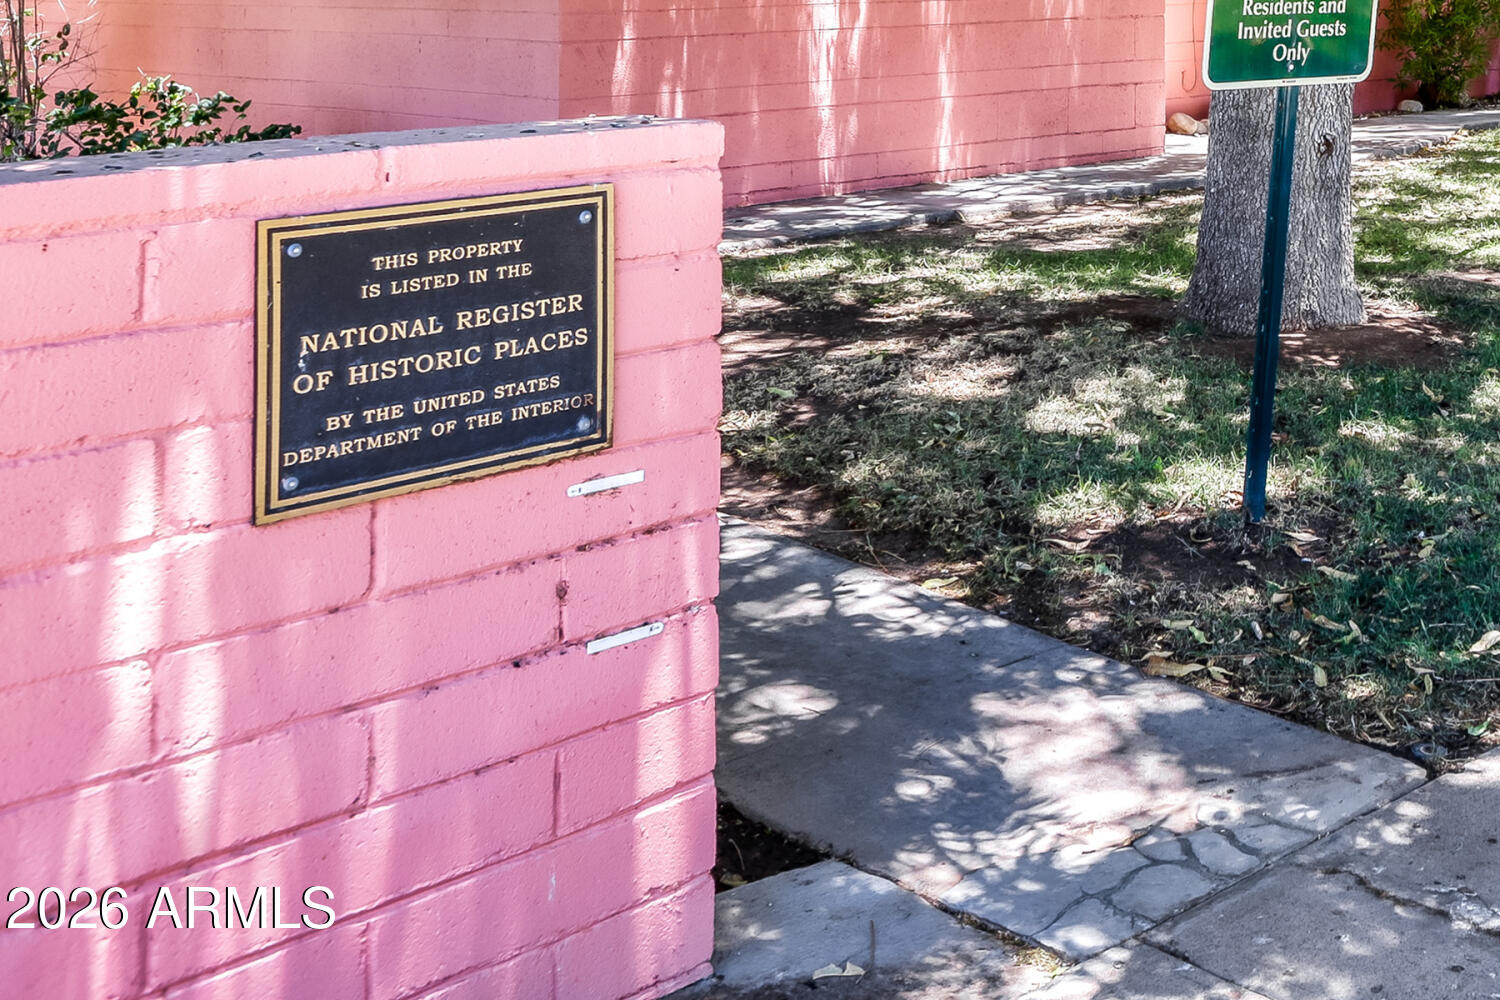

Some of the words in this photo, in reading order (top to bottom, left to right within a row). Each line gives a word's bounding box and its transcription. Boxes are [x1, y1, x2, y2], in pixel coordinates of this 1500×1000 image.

[1238, 17, 1292, 39] Invited
[1297, 20, 1347, 38] Guests
[1273, 42, 1310, 66] Only
[372, 253, 418, 271] THIS
[428, 239, 523, 264] PROPERTY
[361, 284, 380, 299] IS
[391, 273, 459, 295] LISTED
[469, 269, 488, 283] IN
[497, 263, 533, 279] THE
[300, 316, 444, 355] NATIONAL
[456, 294, 583, 330] REGISTER
[293, 370, 333, 394] OF
[348, 346, 481, 385] HISTORIC
[494, 328, 588, 360] PLACES
[326, 414, 354, 431] BY
[363, 405, 404, 424] THE
[414, 390, 485, 414] UNITED
[494, 376, 560, 399] STATES
[283, 427, 422, 467] DEPARTMENT
[432, 421, 457, 437] OF
[466, 411, 503, 430] THE
[511, 394, 594, 421] INTERIOR
